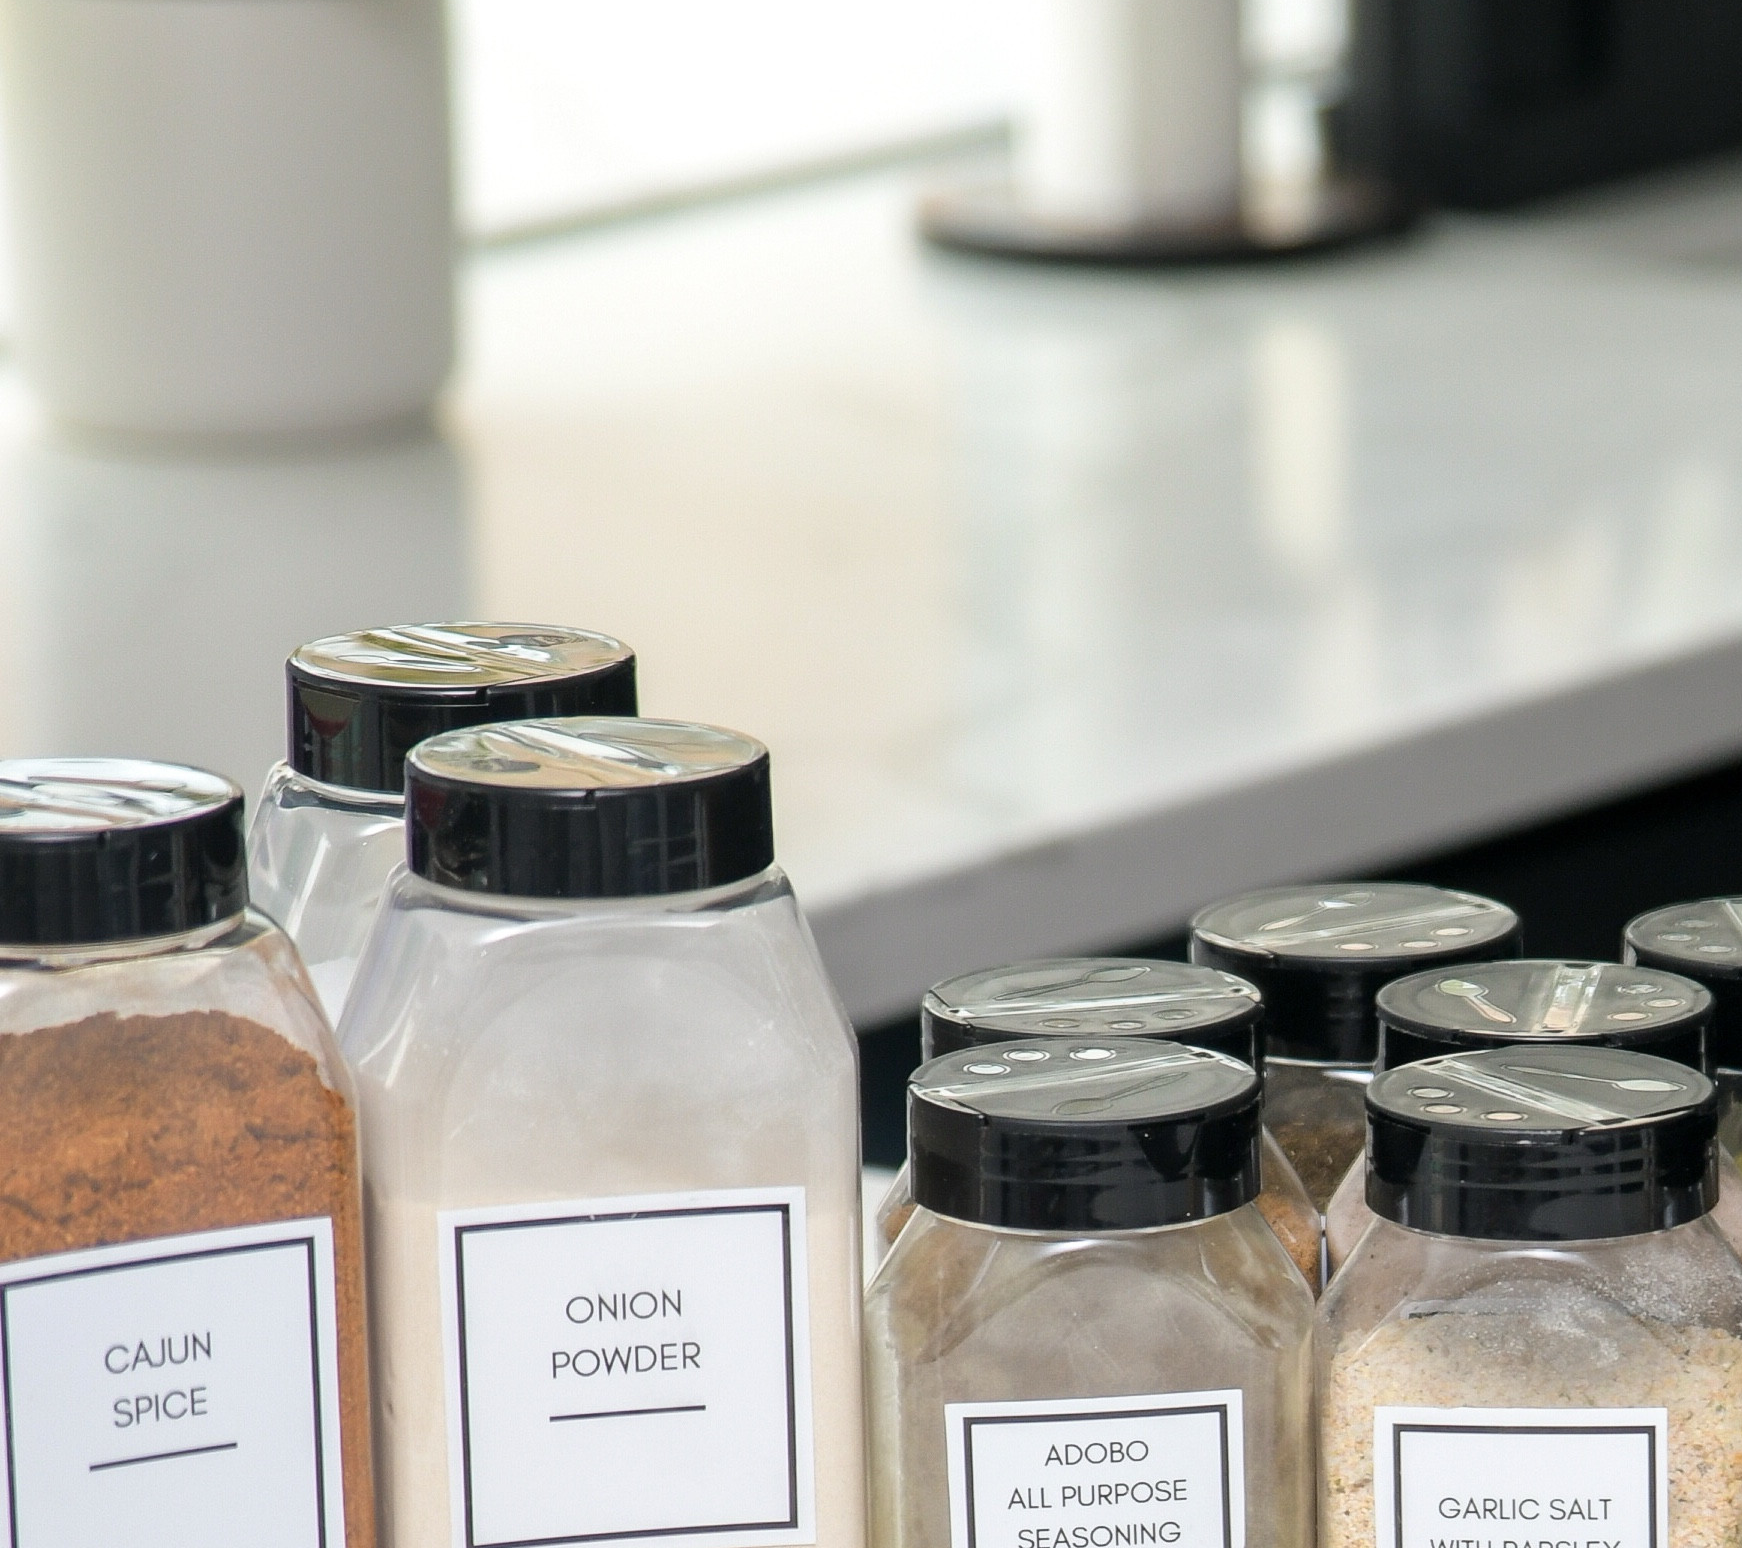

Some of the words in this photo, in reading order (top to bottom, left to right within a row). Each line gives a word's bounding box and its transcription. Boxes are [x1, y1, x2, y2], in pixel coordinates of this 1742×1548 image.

[565, 1288, 682, 1325] ONION
[104, 1331, 212, 1375] CAJUN
[551, 1341, 701, 1380] POWDER
[113, 1386, 208, 1429] SPICE
[1044, 1439, 1150, 1467] ADOBO
[1007, 1486, 1053, 1511] ALL
[1061, 1478, 1188, 1508] PURPOSE
[1438, 1496, 1540, 1521] GARLIC
[1549, 1497, 1613, 1521] SALT
